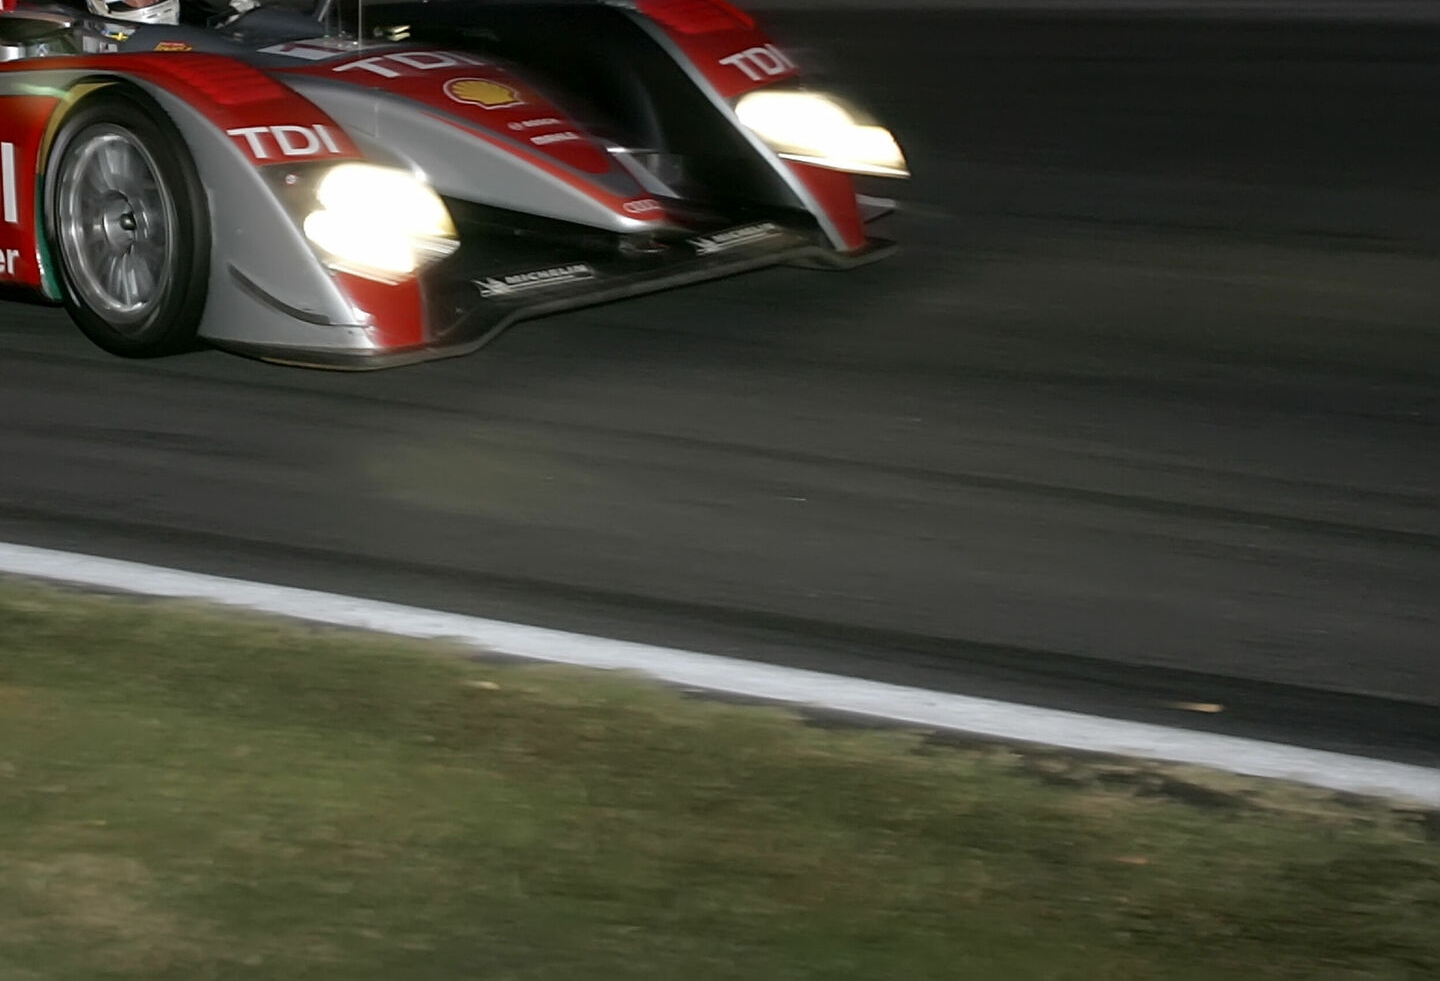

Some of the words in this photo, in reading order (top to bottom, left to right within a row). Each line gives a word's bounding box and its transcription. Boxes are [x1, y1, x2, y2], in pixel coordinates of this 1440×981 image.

[332, 51, 485, 78] TDI
[718, 43, 797, 81] TDI
[226, 124, 341, 159] TDI
